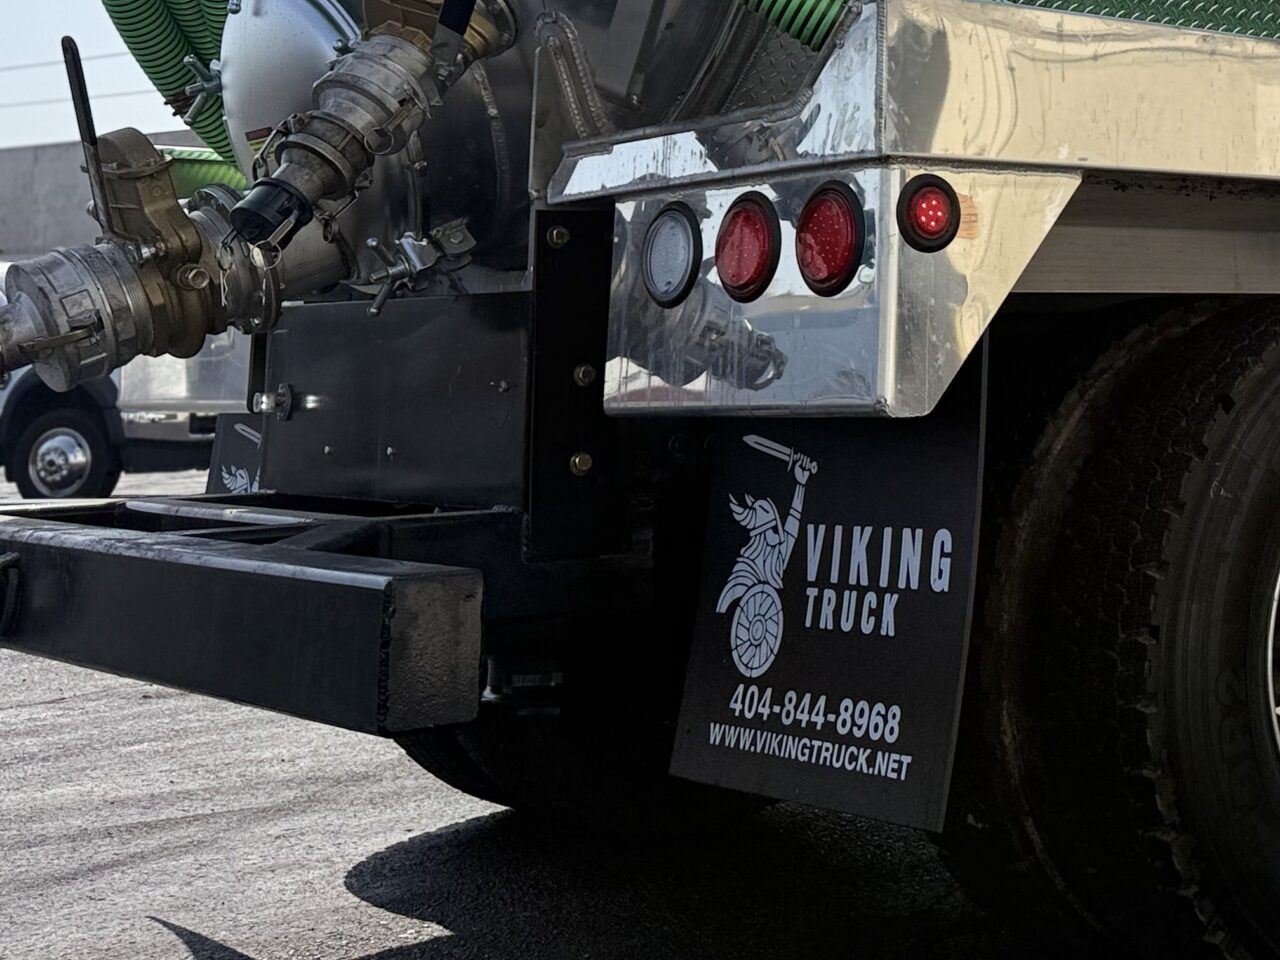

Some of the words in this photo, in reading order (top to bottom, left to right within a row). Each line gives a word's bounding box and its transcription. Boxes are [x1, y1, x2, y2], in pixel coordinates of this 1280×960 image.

[807, 524, 952, 592] VIKING
[805, 588, 899, 636] TRUCK
[730, 684, 901, 744] 404-844-8968
[709, 723, 913, 781] WWW.VIKINGTRUCK.NET
